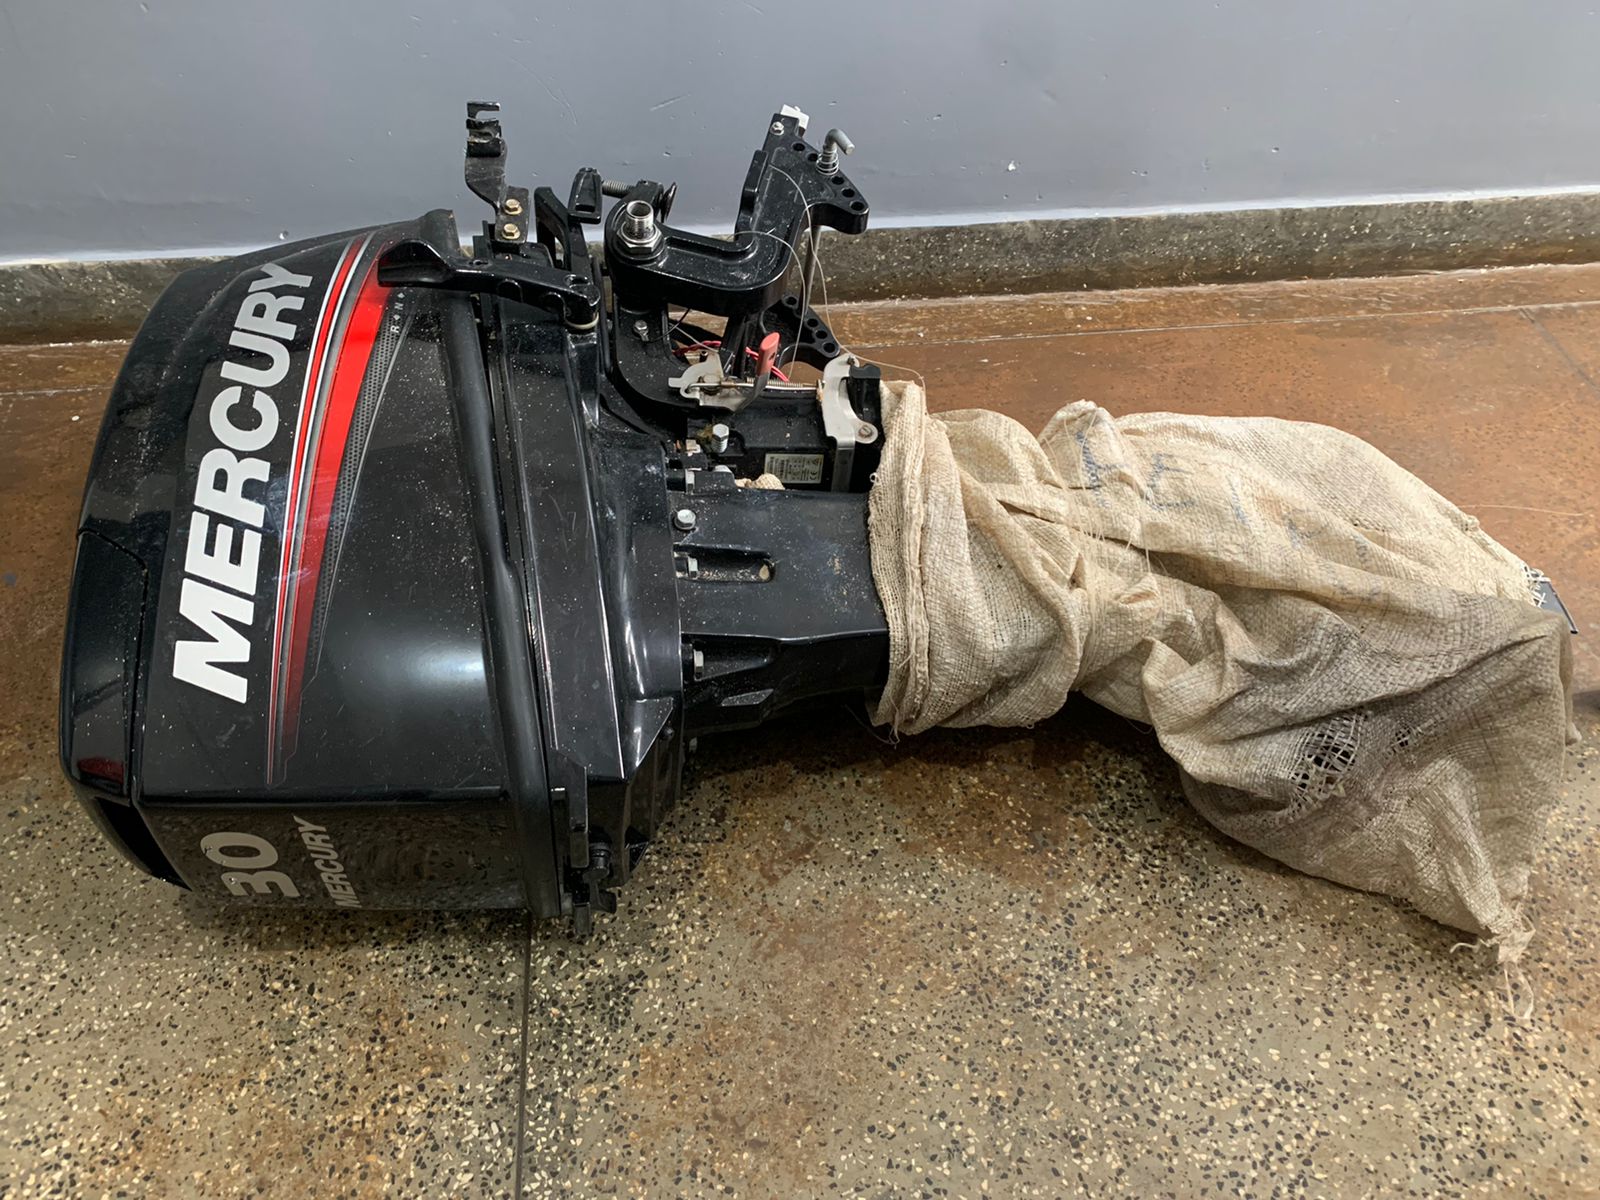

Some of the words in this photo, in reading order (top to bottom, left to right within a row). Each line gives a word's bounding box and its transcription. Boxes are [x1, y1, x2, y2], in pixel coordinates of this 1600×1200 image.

[390, 325, 400, 333] R
[394, 302, 404, 310] N
[172, 262, 313, 704] MERCURY
[200, 831, 300, 898] 30
[293, 815, 362, 908] MERCURY
